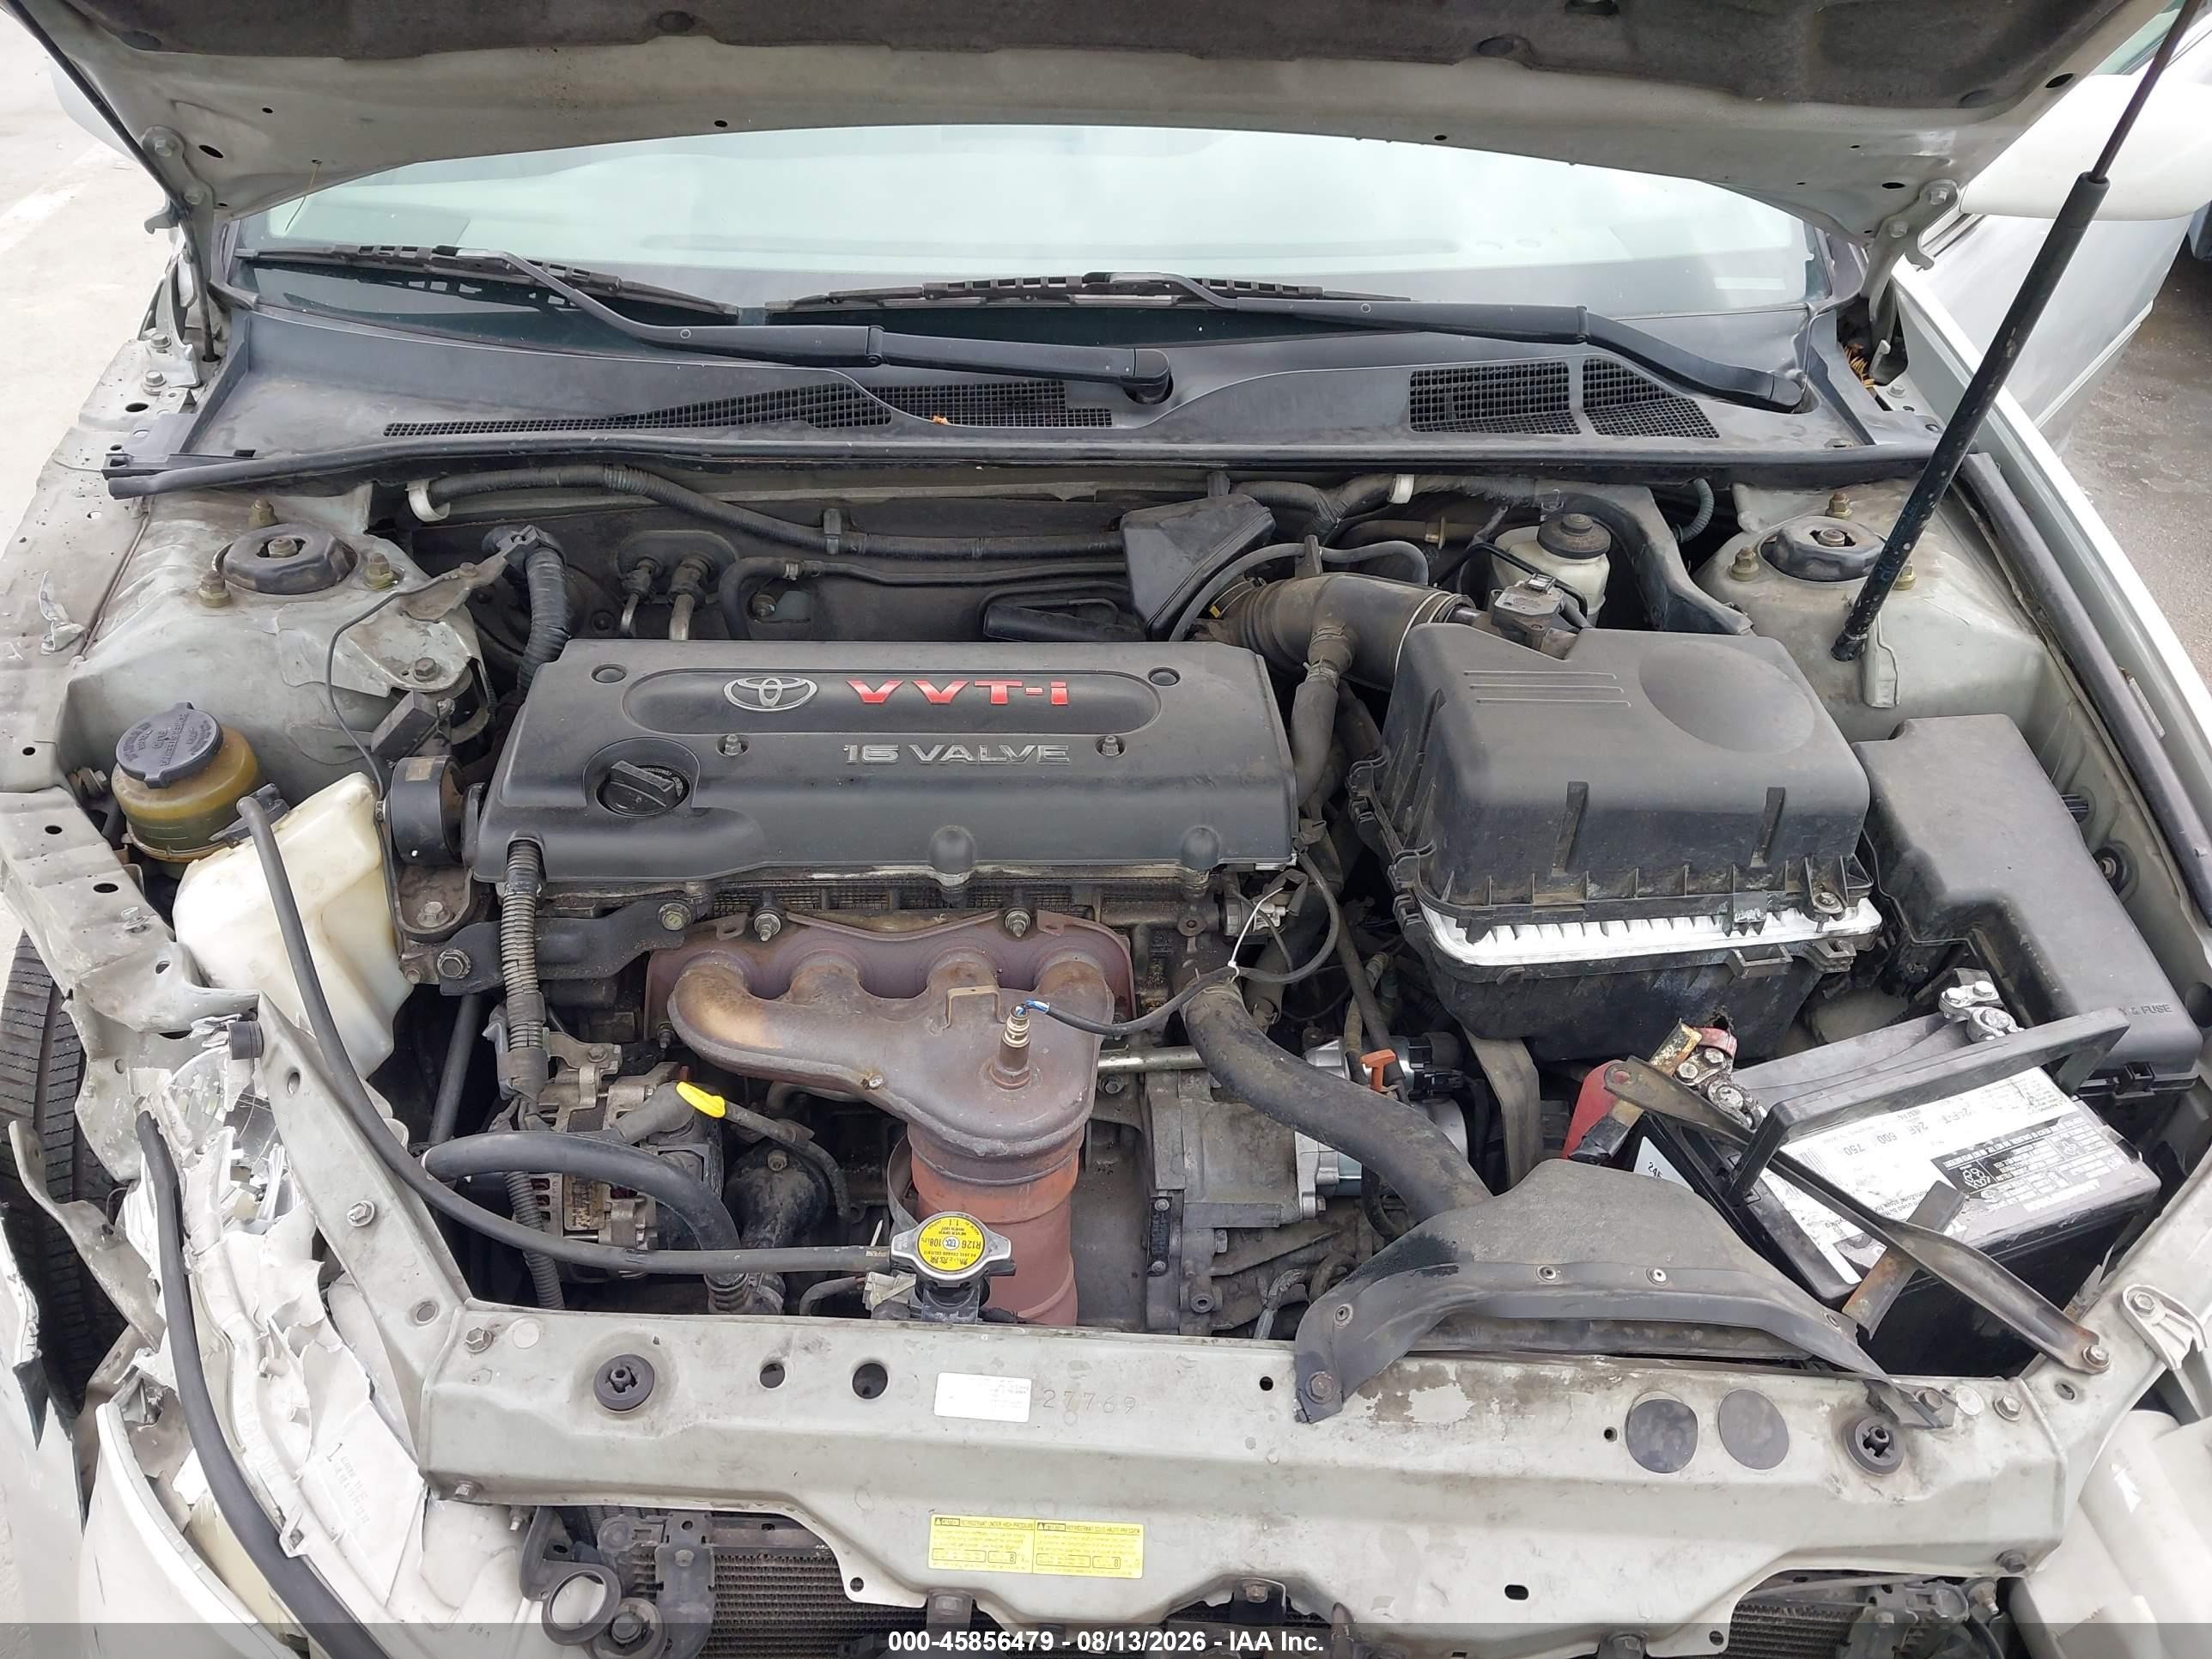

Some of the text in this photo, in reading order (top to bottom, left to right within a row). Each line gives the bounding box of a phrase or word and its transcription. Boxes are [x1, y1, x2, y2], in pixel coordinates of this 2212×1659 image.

[847, 680, 1068, 705] VVT-i
[843, 744, 1070, 764] 16 VALVE
[2142, 1003, 2172, 1014] FUSE
[1909, 1121, 1929, 1135] 24F
[1876, 1132, 1898, 1145] 600
[1843, 1143, 1865, 1156] 750
[962, 1240, 981, 1249] R126
[1042, 1389, 1137, 1414] 27769
